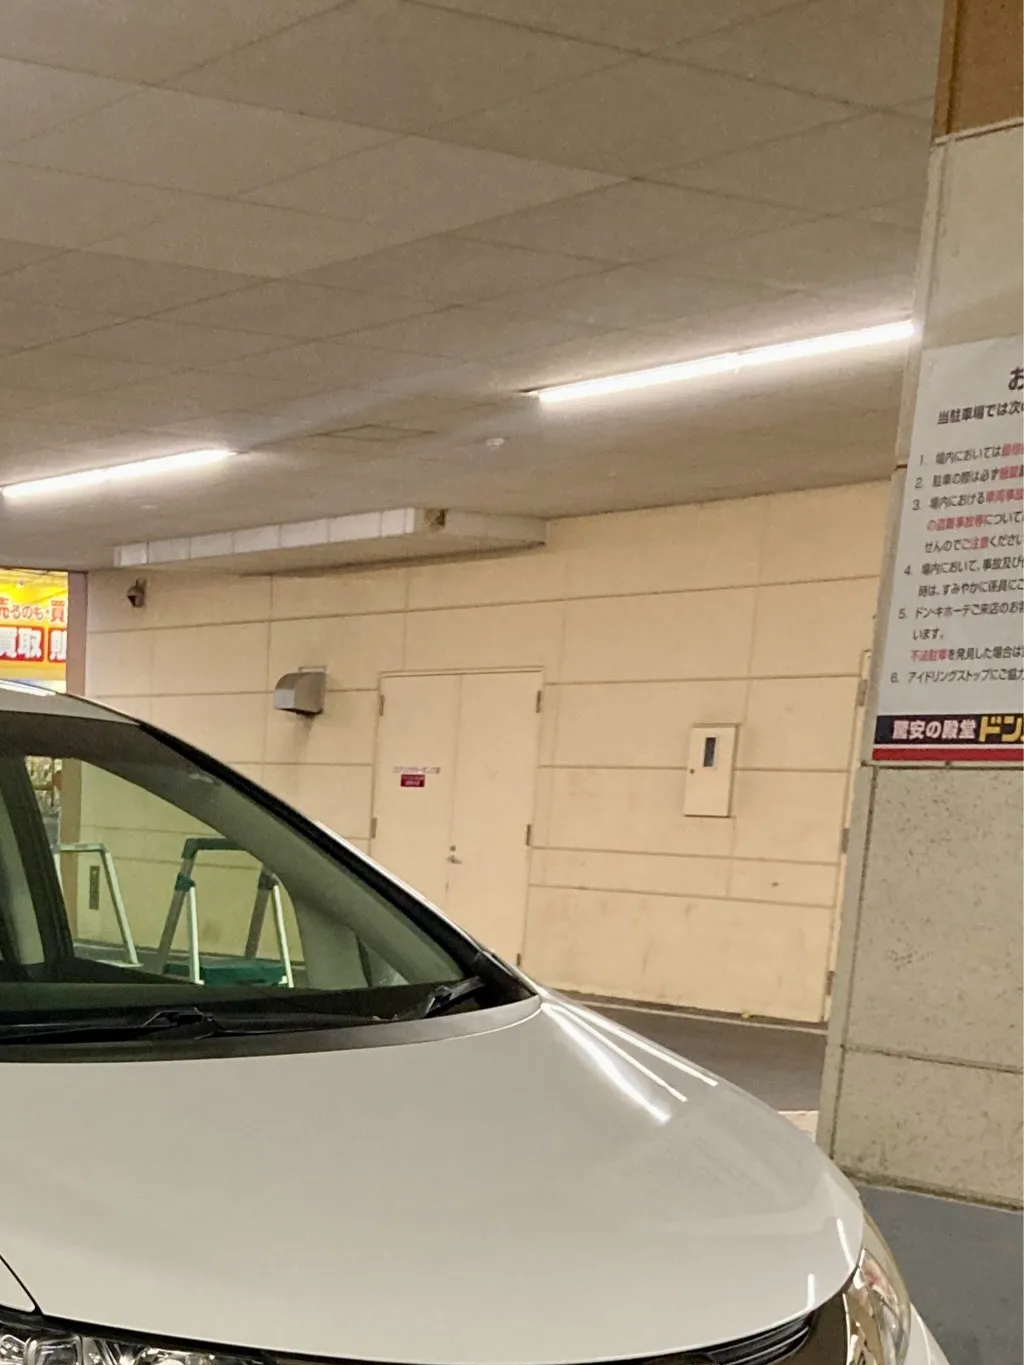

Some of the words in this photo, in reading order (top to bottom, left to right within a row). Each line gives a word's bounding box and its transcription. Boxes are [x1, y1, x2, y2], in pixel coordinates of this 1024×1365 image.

[921, 556, 1024, 576] 場内において、事故及び
[910, 645, 1024, 662] 不法駐車を発見した場合は
